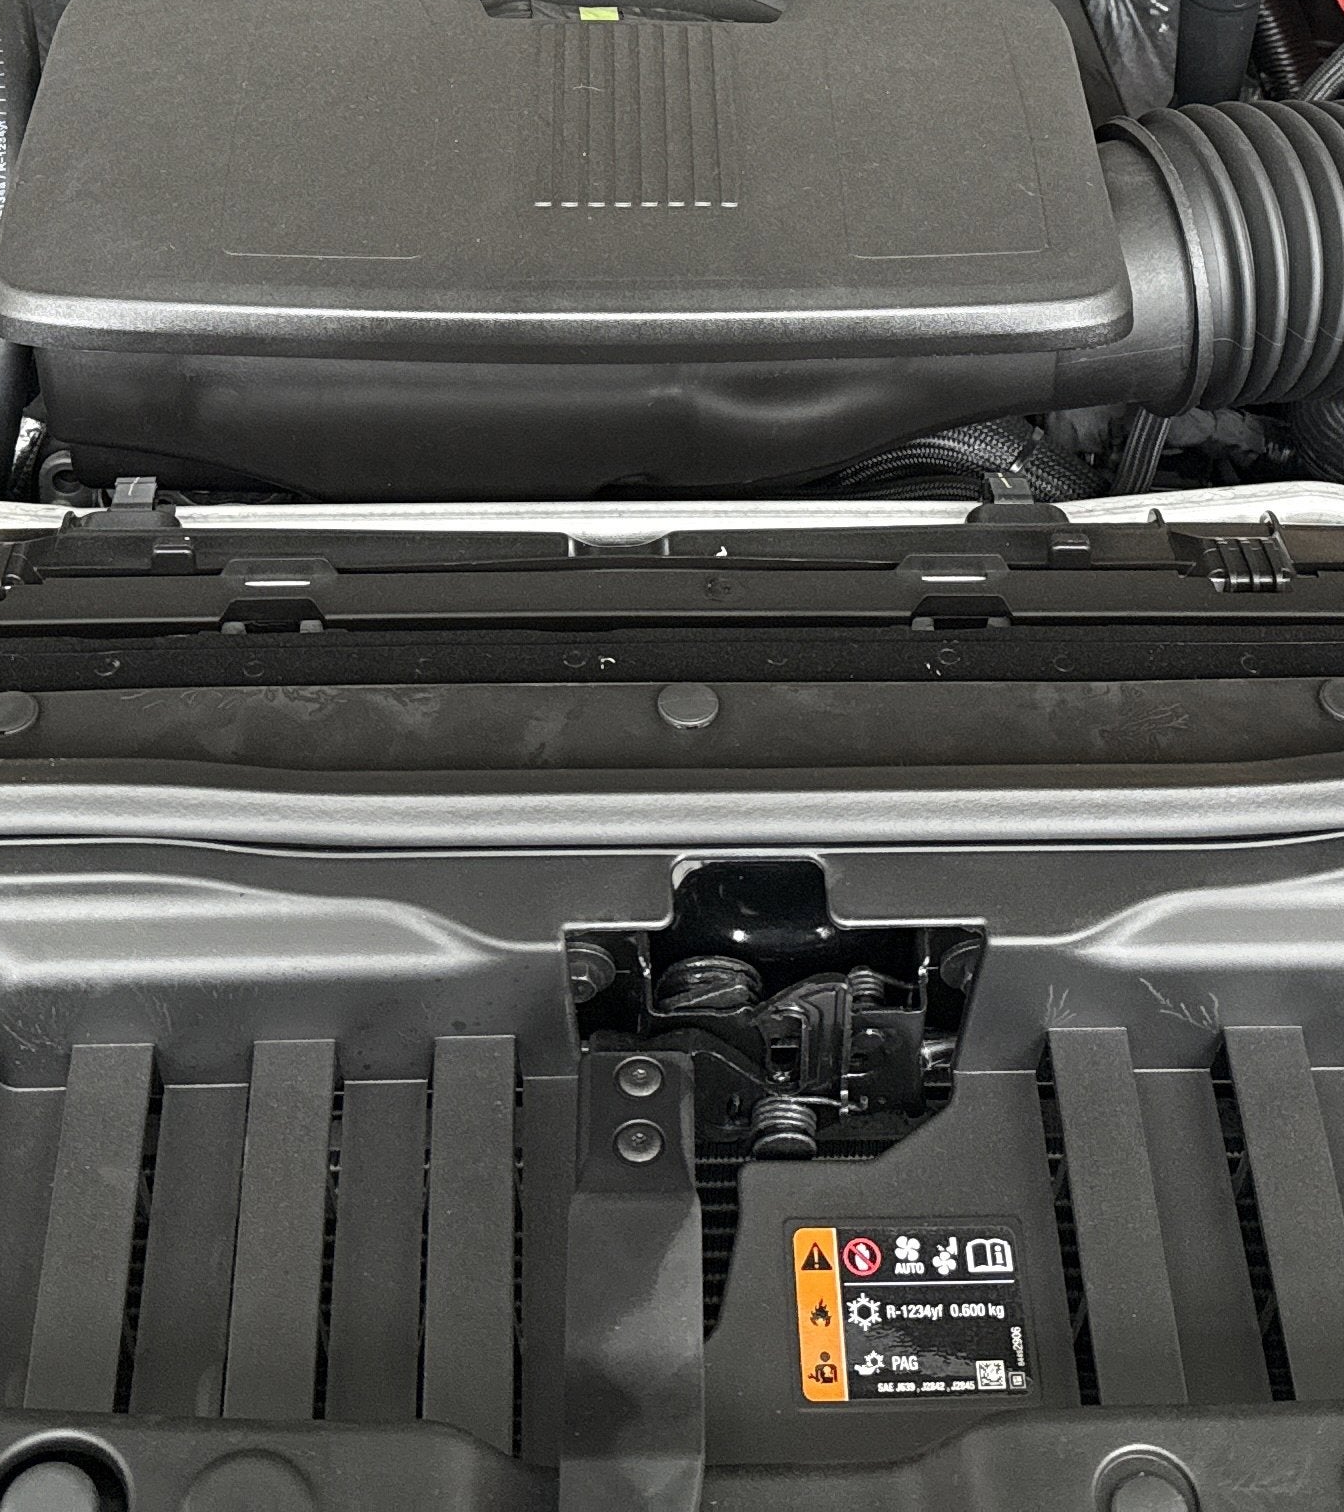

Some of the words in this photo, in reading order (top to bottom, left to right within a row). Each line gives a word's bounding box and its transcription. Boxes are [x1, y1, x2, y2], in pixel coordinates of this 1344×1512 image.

[895, 1262, 925, 1274] AUTO
[886, 1304, 943, 1321] R-1234yf
[950, 1303, 985, 1317] 0.600
[988, 1303, 1004, 1319] kg
[892, 1356, 918, 1371] PAG
[877, 1382, 894, 1392] SAE
